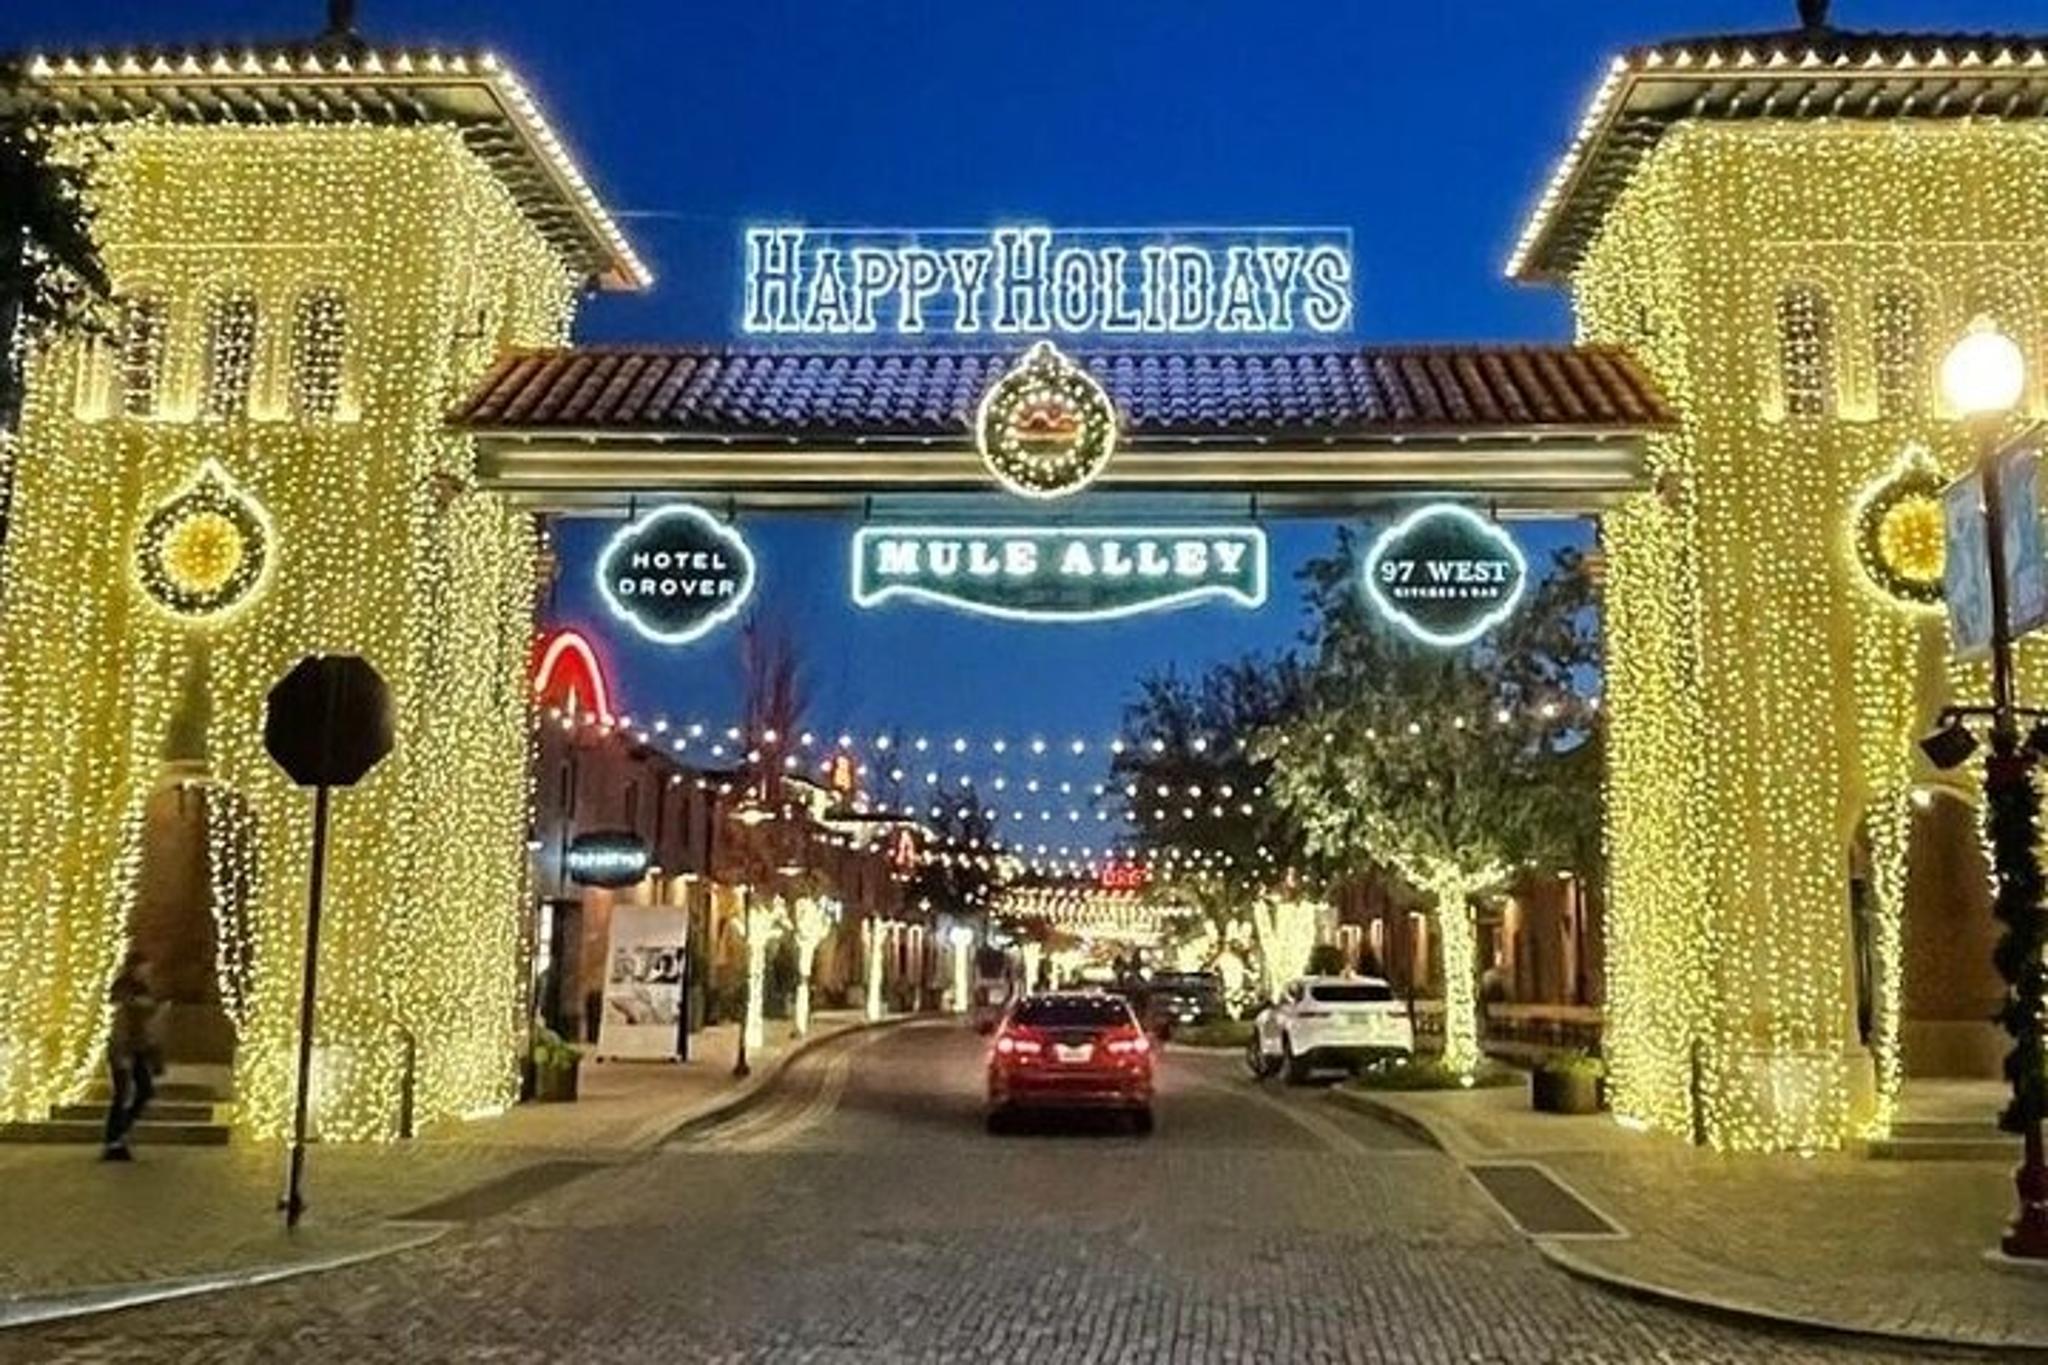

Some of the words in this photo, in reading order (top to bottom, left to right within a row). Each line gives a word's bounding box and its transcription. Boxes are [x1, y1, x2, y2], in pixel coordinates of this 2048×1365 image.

[632, 552, 727, 570] HOTEL
[877, 540, 1038, 575] MULE
[1060, 540, 1247, 575] ALLEY
[1381, 560, 1415, 582] 97
[1426, 560, 1510, 582] WEST
[619, 578, 735, 595] DROVER
